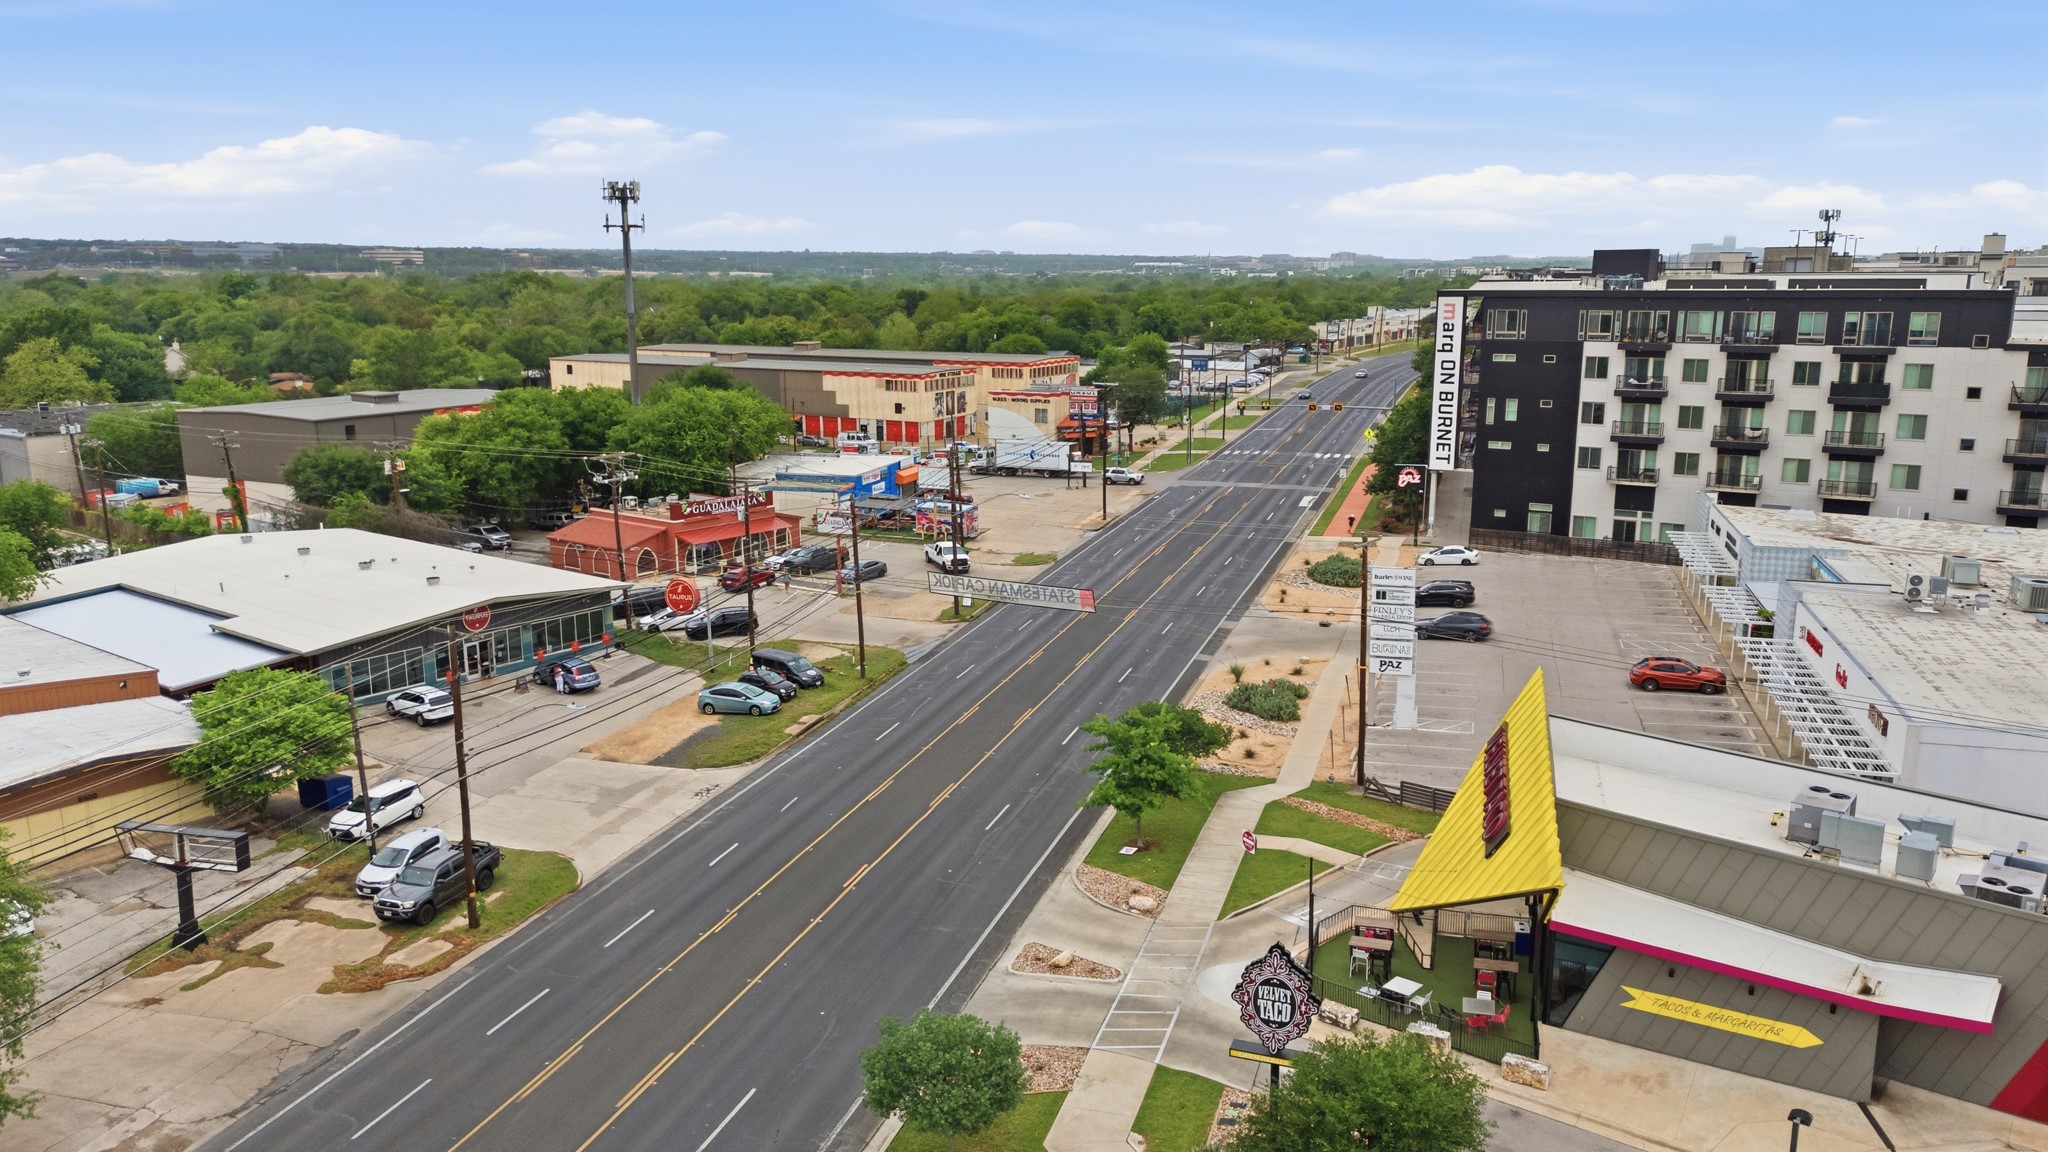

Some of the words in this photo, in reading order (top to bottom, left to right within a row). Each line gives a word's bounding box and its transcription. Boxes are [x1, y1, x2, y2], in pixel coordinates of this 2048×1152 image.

[1437, 303, 1456, 352] marq
[1440, 360, 1455, 385] ON
[1435, 392, 1454, 464] BURNET
[1398, 474, 1421, 488] PAZ
[669, 593, 693, 601] TAURUS
[465, 612, 488, 621] TAURUS
[1379, 660, 1402, 673] PAZ
[1258, 986, 1291, 1003] VELVET
[1258, 999, 1291, 1022] TACO
[1651, 998, 1692, 1015] TACOS
[1692, 1008, 1701, 1018] &
[1704, 1011, 1785, 1036] MARGARITAS
